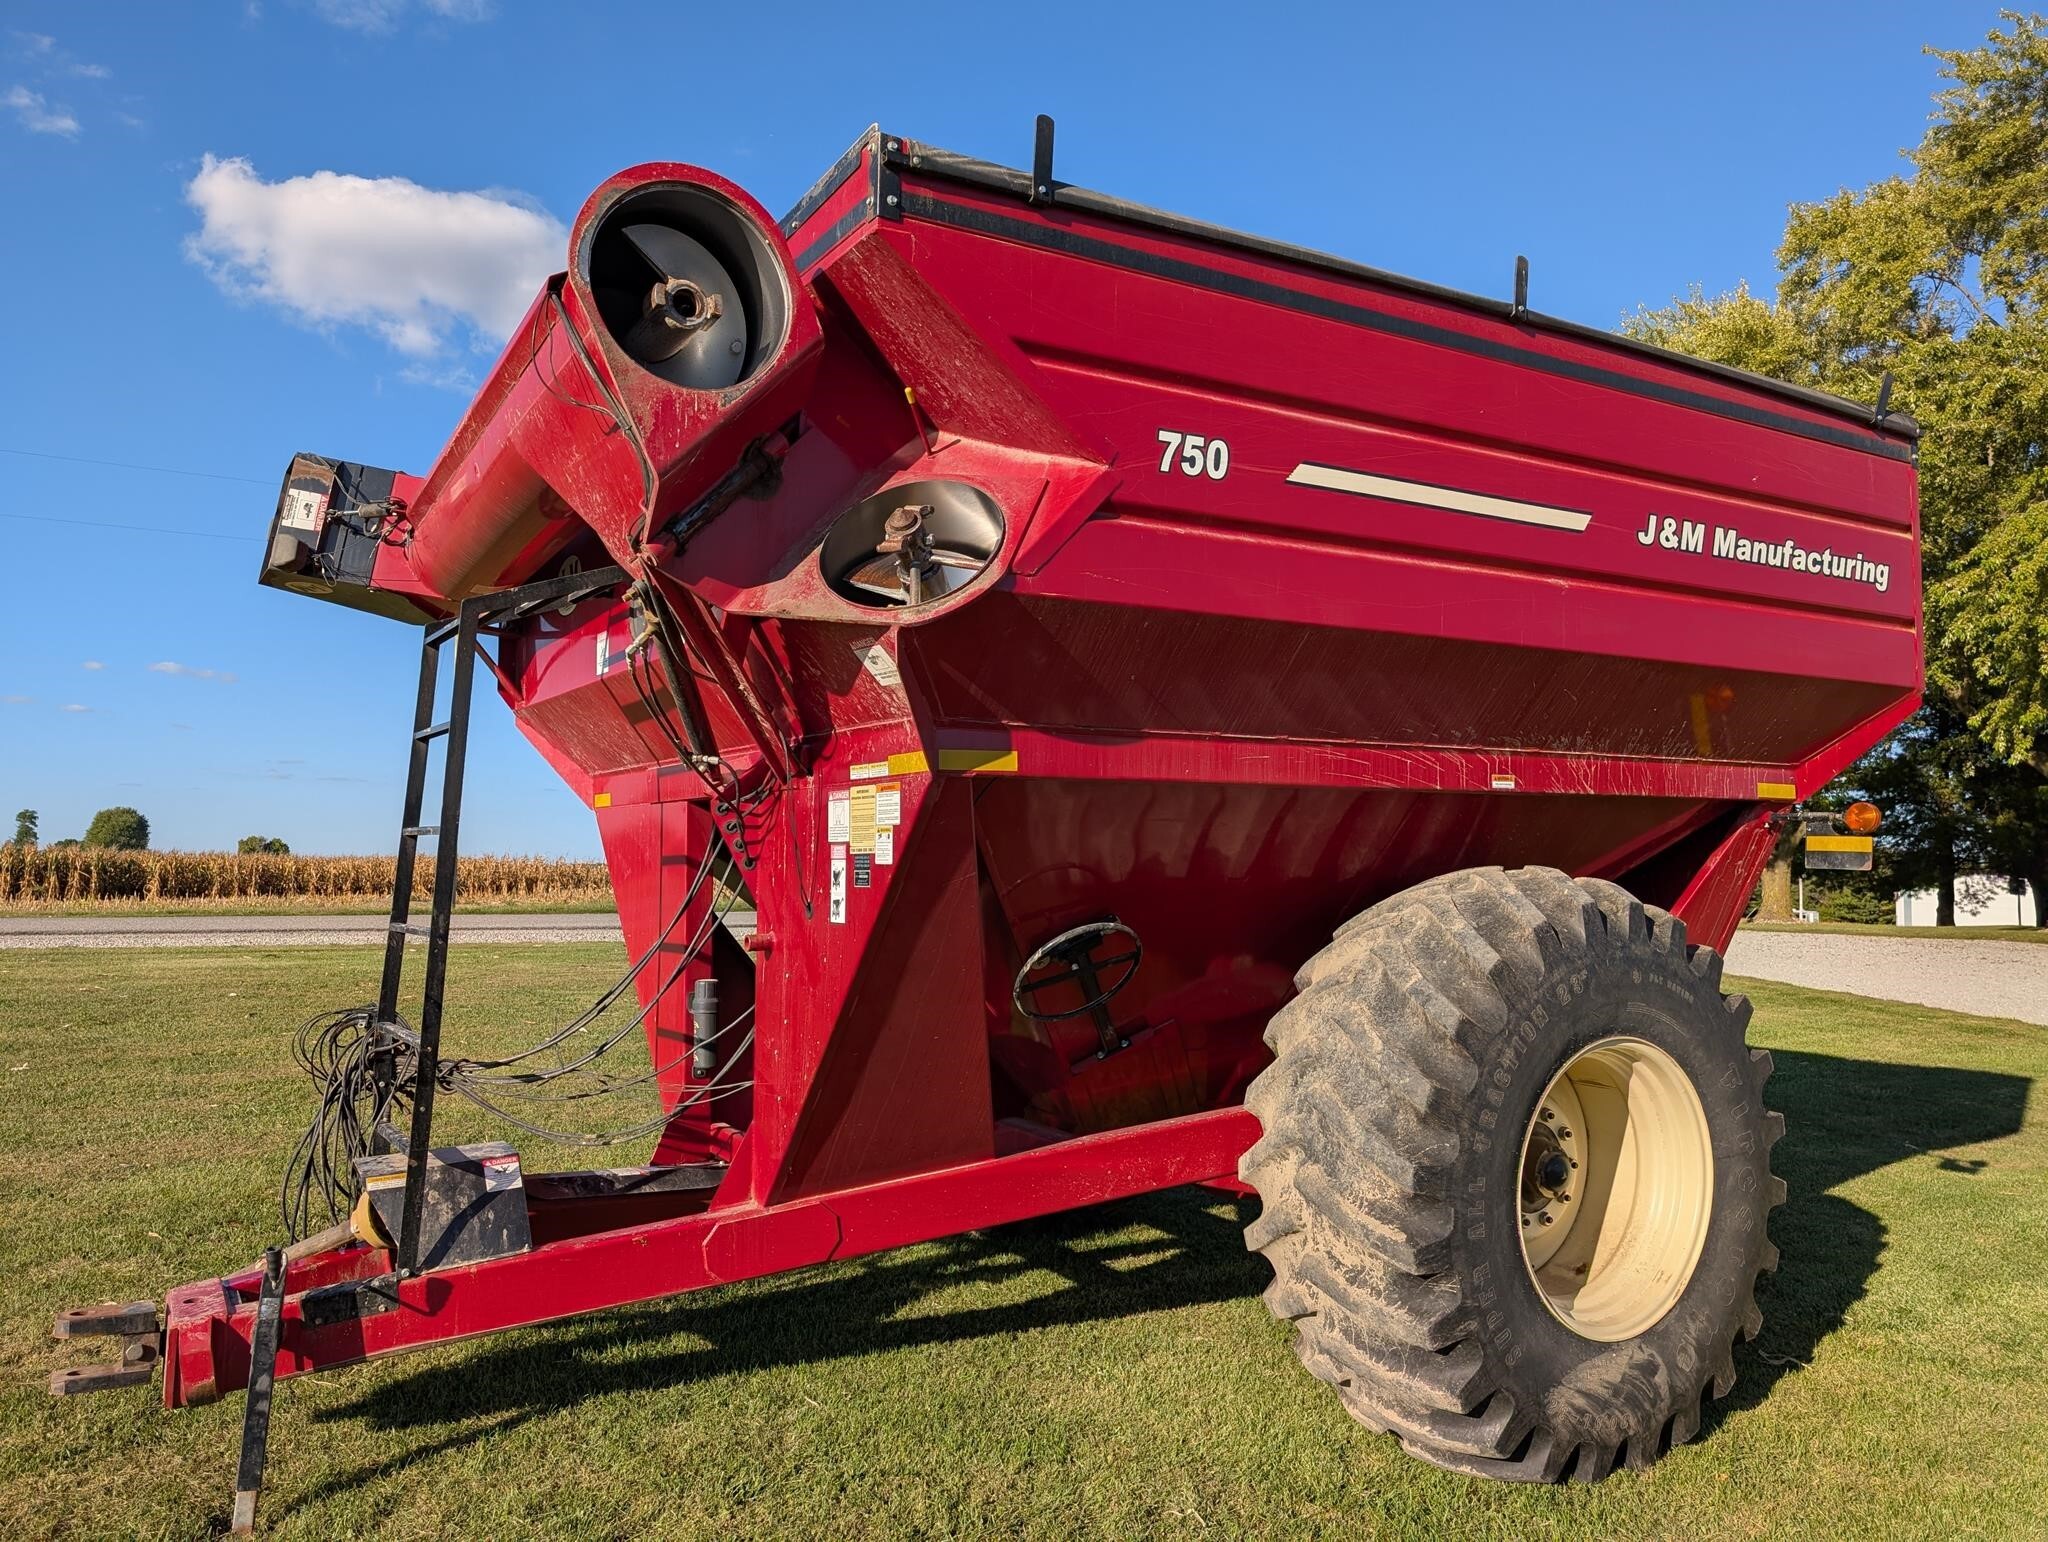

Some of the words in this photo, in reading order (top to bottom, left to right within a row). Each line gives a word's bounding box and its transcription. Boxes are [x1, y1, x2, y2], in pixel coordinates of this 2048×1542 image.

[1157, 429, 1229, 481] 750
[1638, 513, 1705, 554] J&M
[1712, 525, 1890, 592] Manufacturing
[1474, 1001, 1549, 1151] TRACTION
[492, 1156, 517, 1166] DANGER
[1467, 1174, 1485, 1240] ALL
[1472, 1261, 1522, 1371] SUPER
